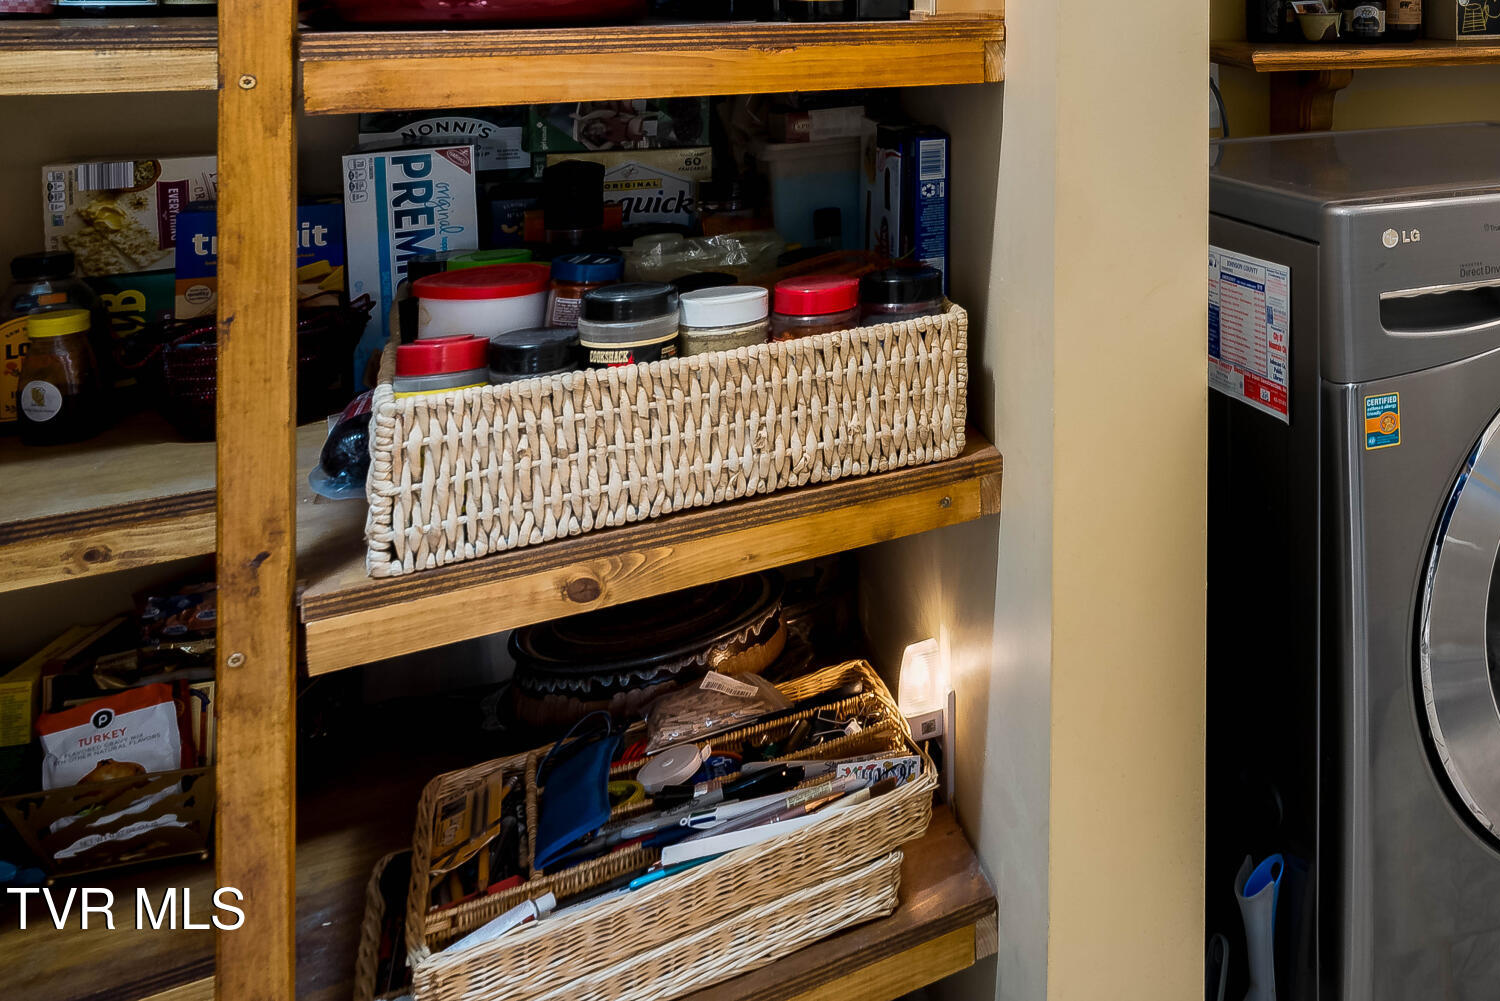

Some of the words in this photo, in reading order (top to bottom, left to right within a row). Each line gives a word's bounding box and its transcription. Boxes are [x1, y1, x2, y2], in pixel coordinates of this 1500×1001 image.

[402, 121, 492, 139] NONNI'S
[604, 182, 658, 190] ORIGINAL
[1401, 229, 1421, 243] LG
[1460, 265, 1485, 278] Direct
[1366, 395, 1397, 407] CERTIFIED
[78, 727, 128, 748] TURKEY
